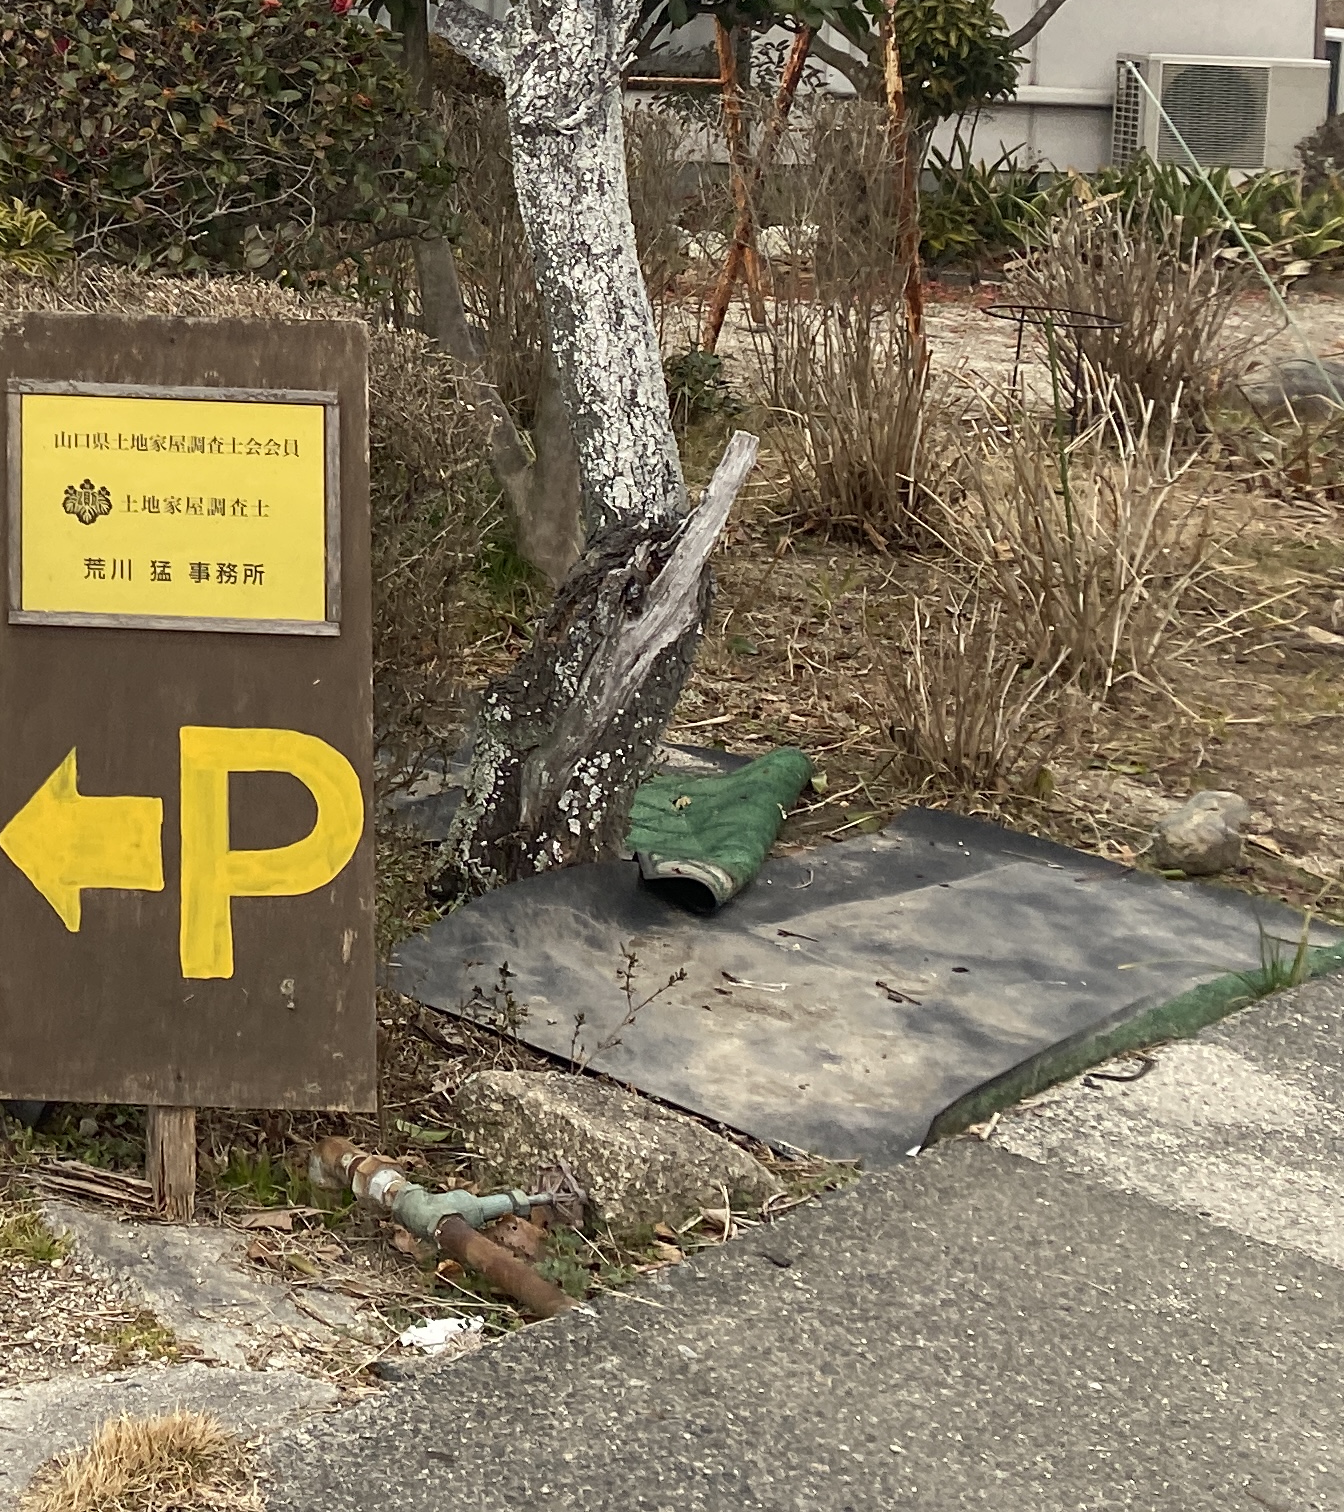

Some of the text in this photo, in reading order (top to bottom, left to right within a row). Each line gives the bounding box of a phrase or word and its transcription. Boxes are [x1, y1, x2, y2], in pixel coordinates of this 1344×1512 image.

[53, 430, 300, 458] 山口県土地家屋調査士会会員
[119, 494, 270, 518] 土地家屋調査士
[83, 557, 266, 586] 荒川 猛 事務所
[179, 725, 365, 980] P
